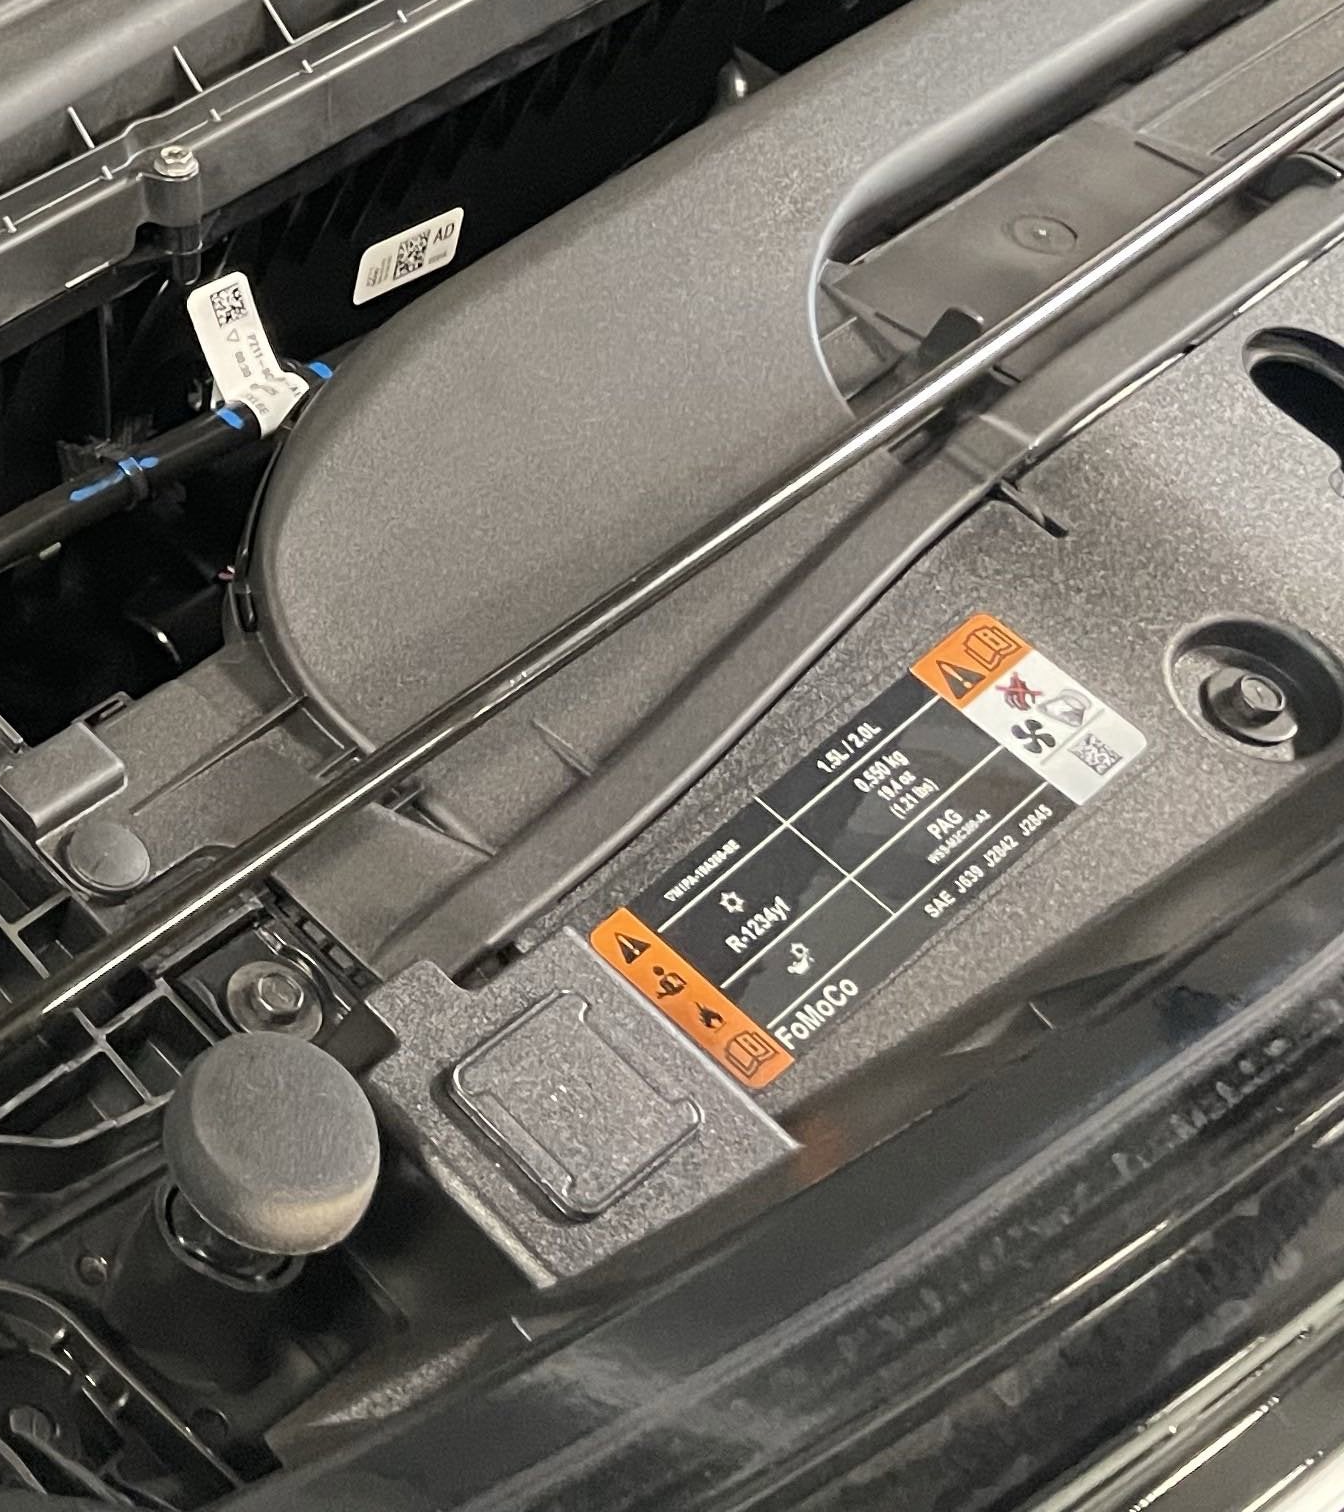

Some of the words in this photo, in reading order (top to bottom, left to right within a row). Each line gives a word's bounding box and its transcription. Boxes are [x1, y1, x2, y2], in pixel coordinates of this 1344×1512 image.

[431, 223, 455, 243] AD
[817, 749, 849, 772] 1.5L
[848, 723, 881, 748] 2.0L
[854, 762, 891, 792] 0.550
[883, 751, 909, 768] kg
[878, 778, 902, 800] 19.4
[899, 771, 916, 784] oz
[890, 793, 919, 819] (1.21
[912, 778, 939, 798] lbs)
[927, 809, 963, 839] PAG
[925, 891, 955, 917] SAE
[955, 865, 984, 893] J639
[983, 836, 1018, 867] J2842
[1019, 804, 1052, 836] J2845
[726, 896, 790, 953] R-1234yf
[775, 980, 858, 1049] FoMoCo
